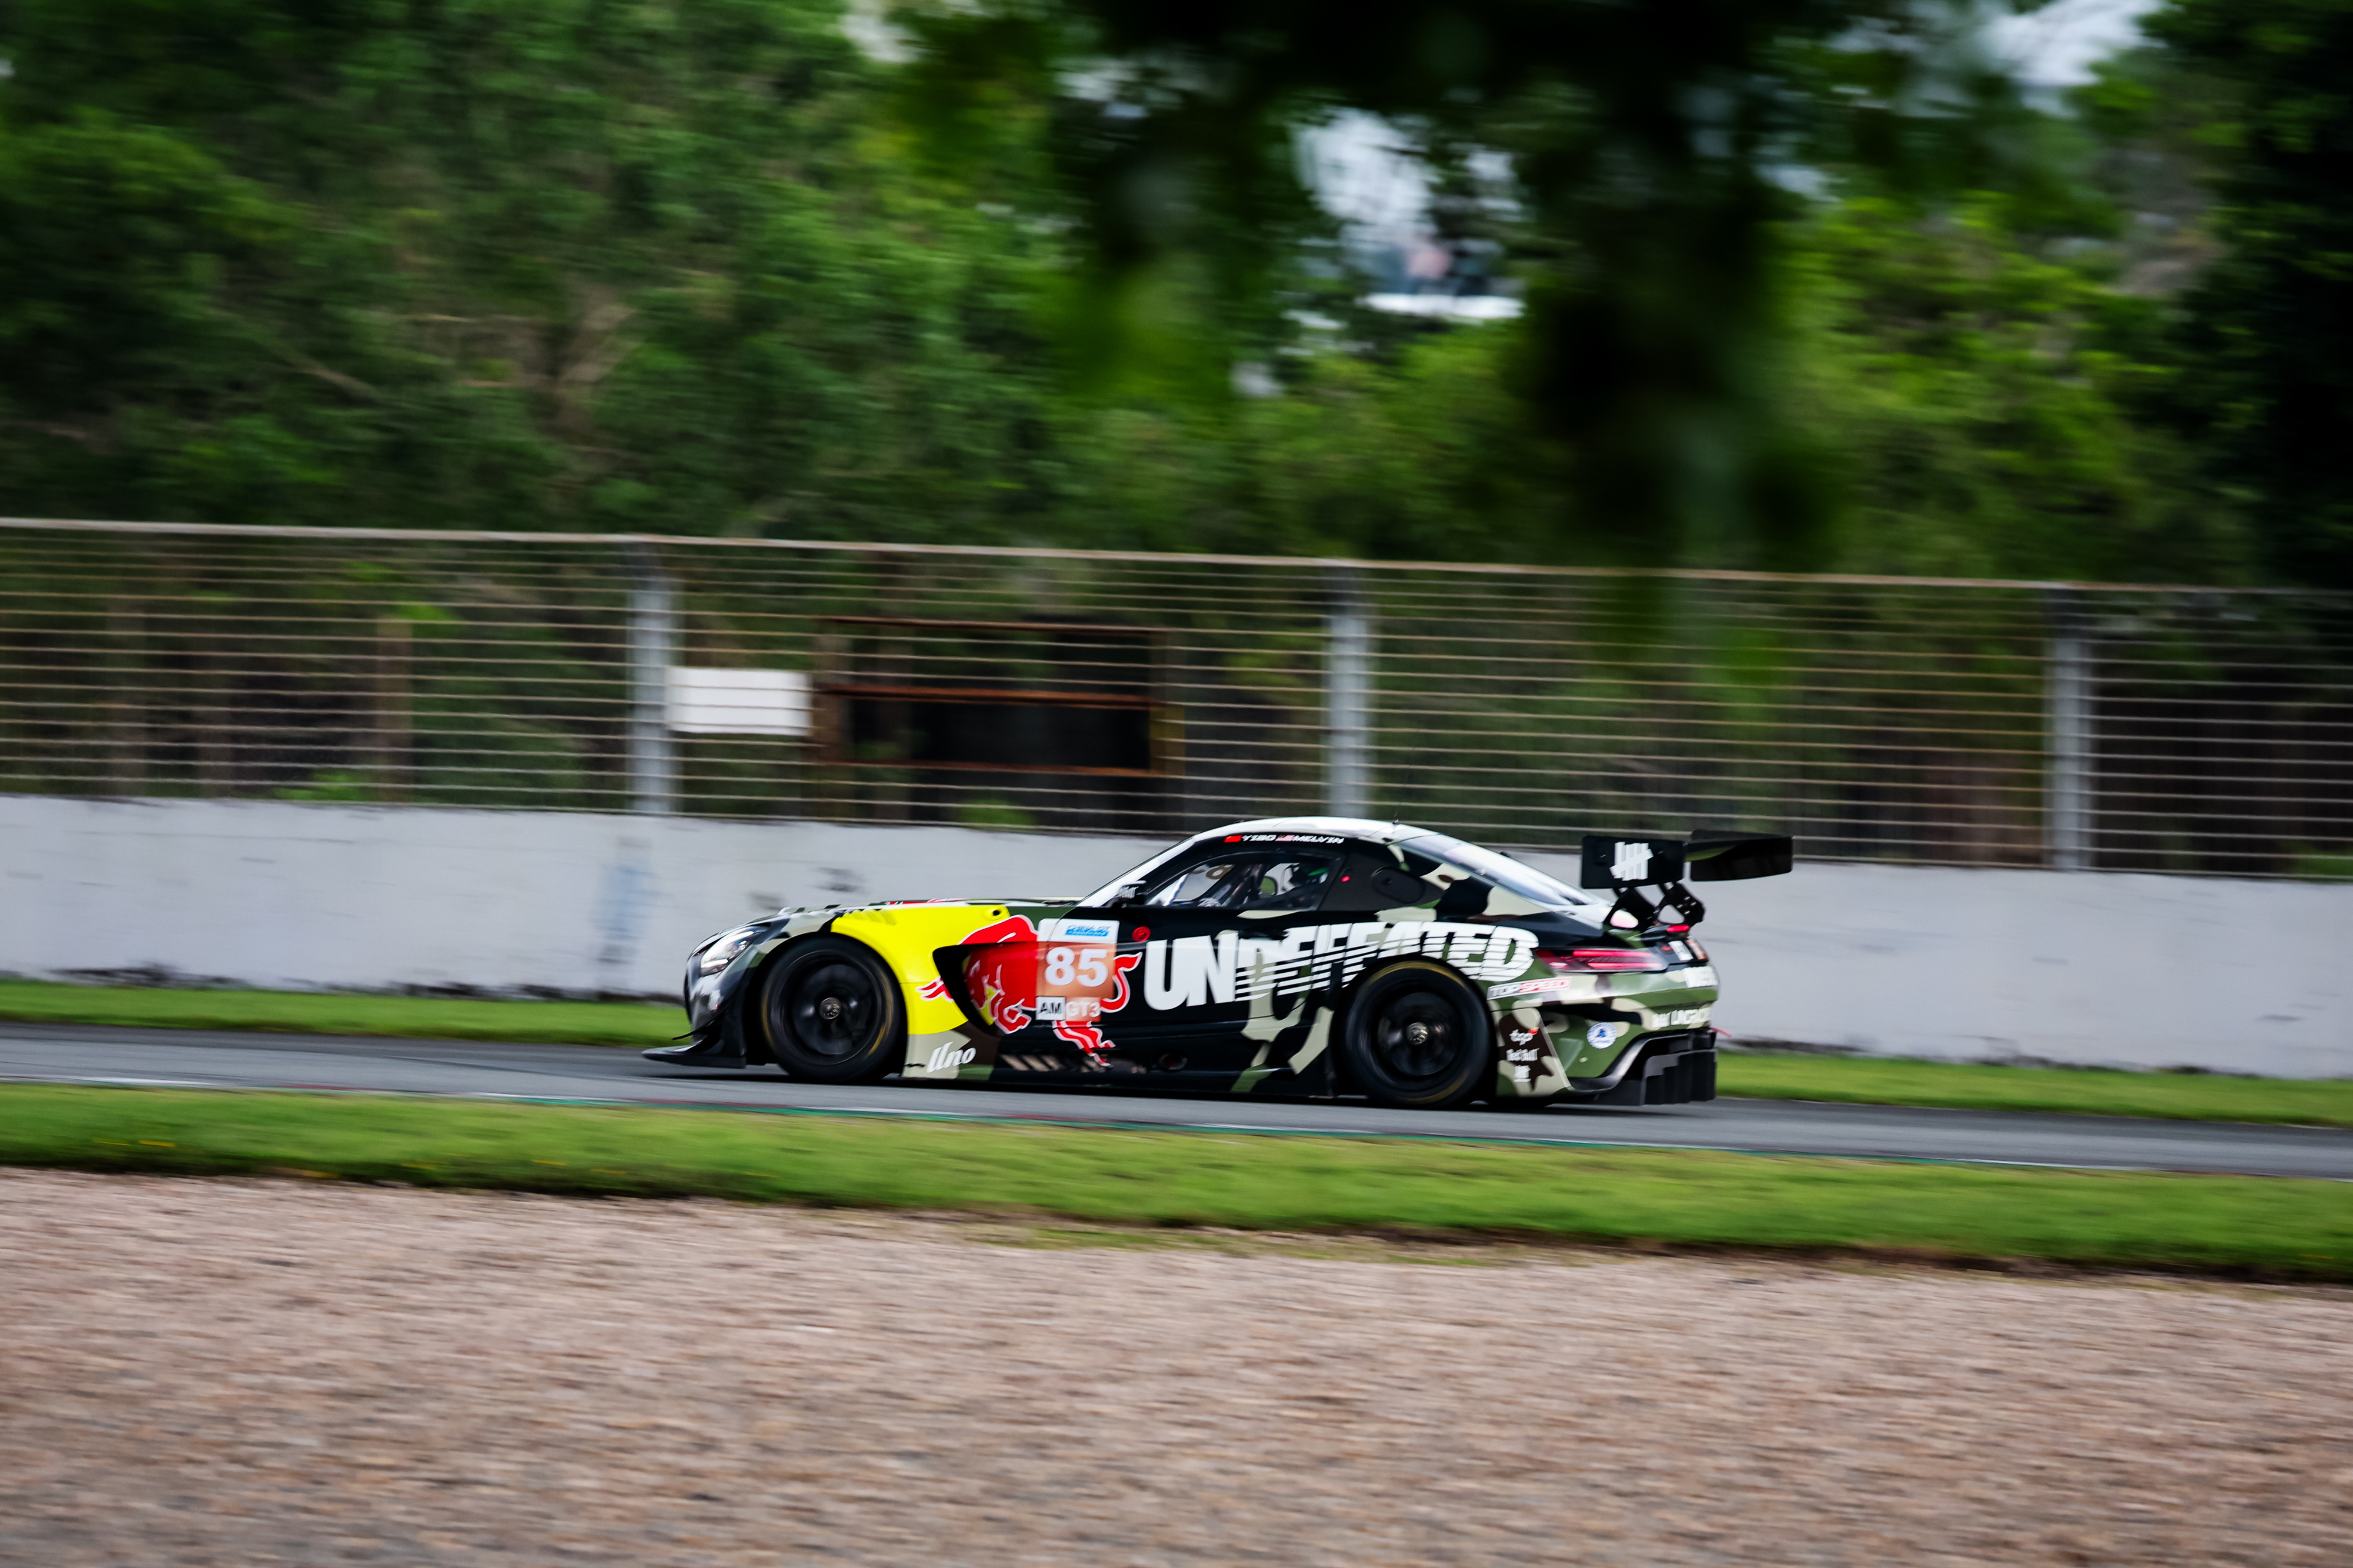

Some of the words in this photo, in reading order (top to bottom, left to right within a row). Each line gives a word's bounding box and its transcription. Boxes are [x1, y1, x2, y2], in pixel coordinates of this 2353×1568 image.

[1044, 946, 1109, 987] 85
[1144, 921, 1539, 1010] UNDEFEATED
[1038, 1002, 1062, 1015] AM
[1065, 1000, 1101, 1018] GT3
